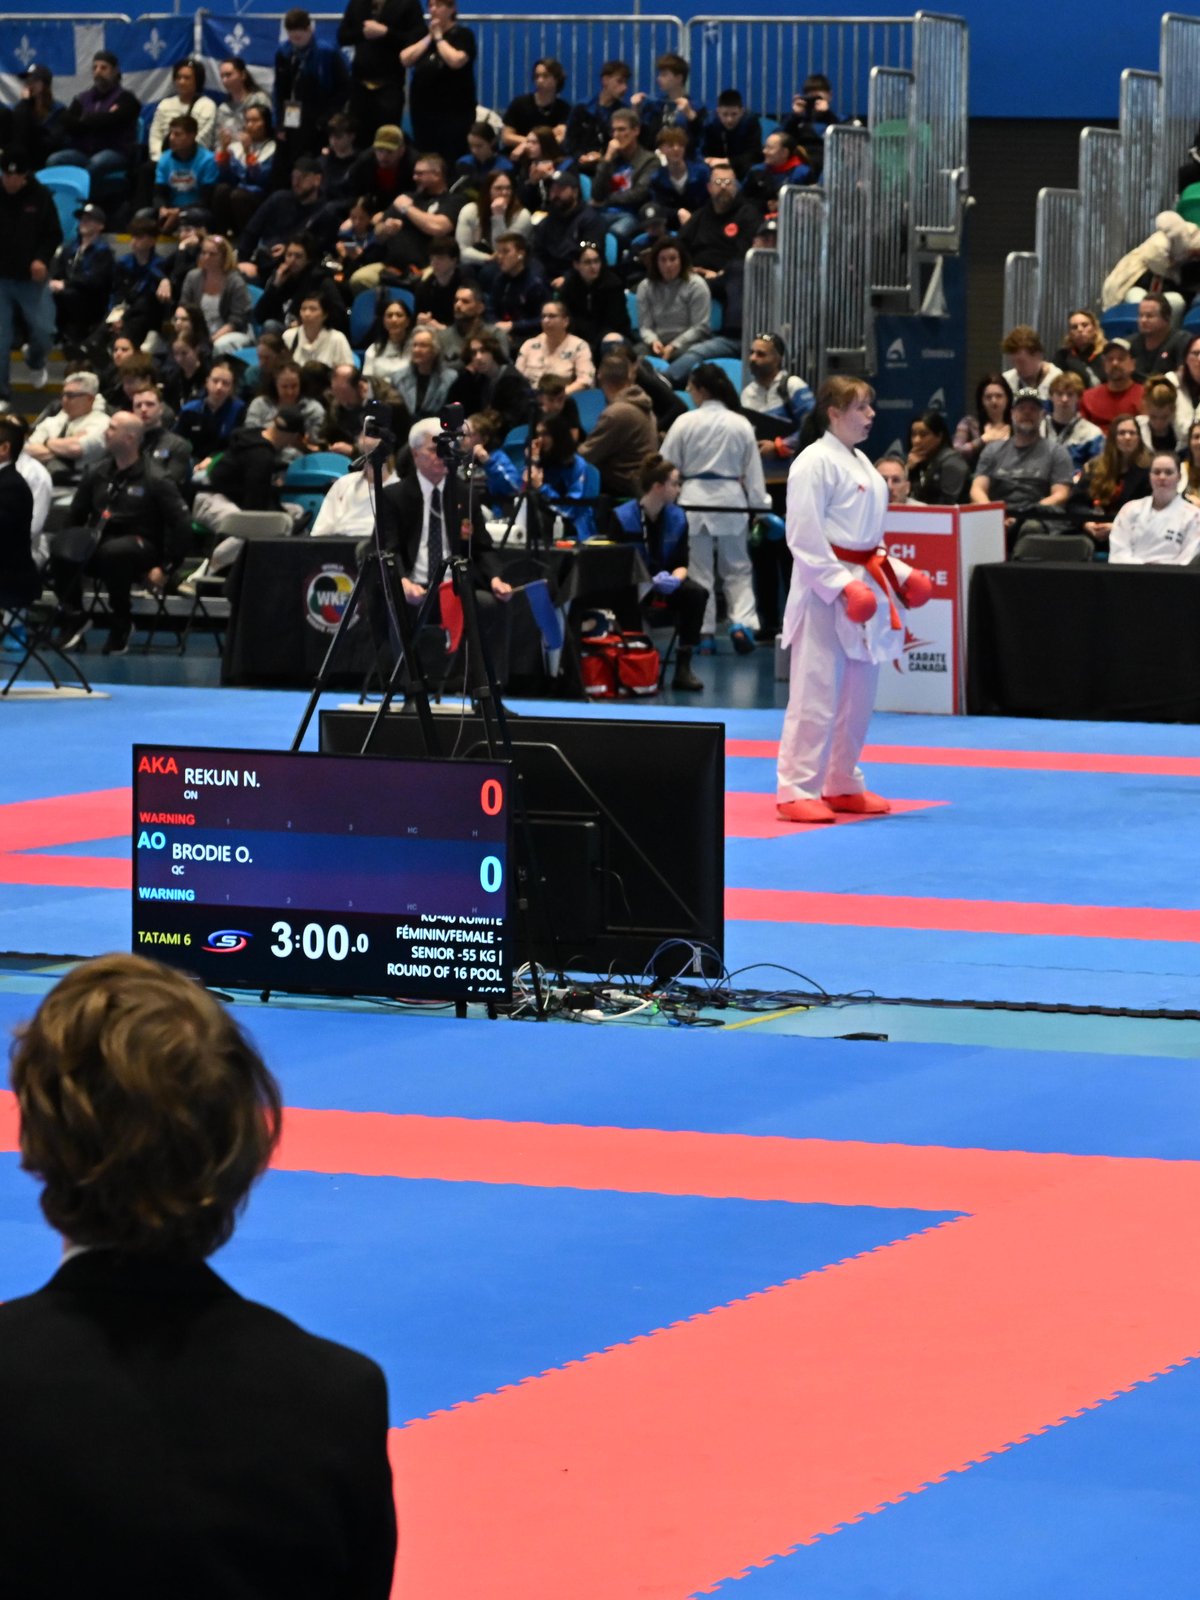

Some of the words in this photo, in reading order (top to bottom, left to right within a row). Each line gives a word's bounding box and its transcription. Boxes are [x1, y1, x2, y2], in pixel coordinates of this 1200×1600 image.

[908, 652, 946, 662] KARATE
[908, 662, 948, 673] CANADA
[138, 756, 178, 775] AKA
[184, 767, 239, 787] REKUN
[243, 770, 260, 788] N.
[183, 789, 198, 800] ON
[480, 779, 503, 816] 0
[139, 812, 195, 825] WARNING
[137, 831, 166, 850] AO
[172, 843, 231, 862] BRODIE
[235, 846, 253, 863] O.
[171, 865, 185, 875] QC
[479, 856, 503, 893] 0
[138, 887, 195, 901] WARNING
[138, 931, 181, 945] TATAMI
[184, 933, 191, 946] 6
[270, 921, 369, 961] 3:00.0
[396, 924, 494, 944] FÉMININ/FEMALE
[411, 946, 455, 960] SENIOR
[457, 948, 477, 961] -55
[479, 950, 496, 962] KG
[387, 963, 431, 977] ROUND
[433, 965, 450, 978] OF
[453, 967, 467, 979] 16
[470, 968, 503, 981] POOL
